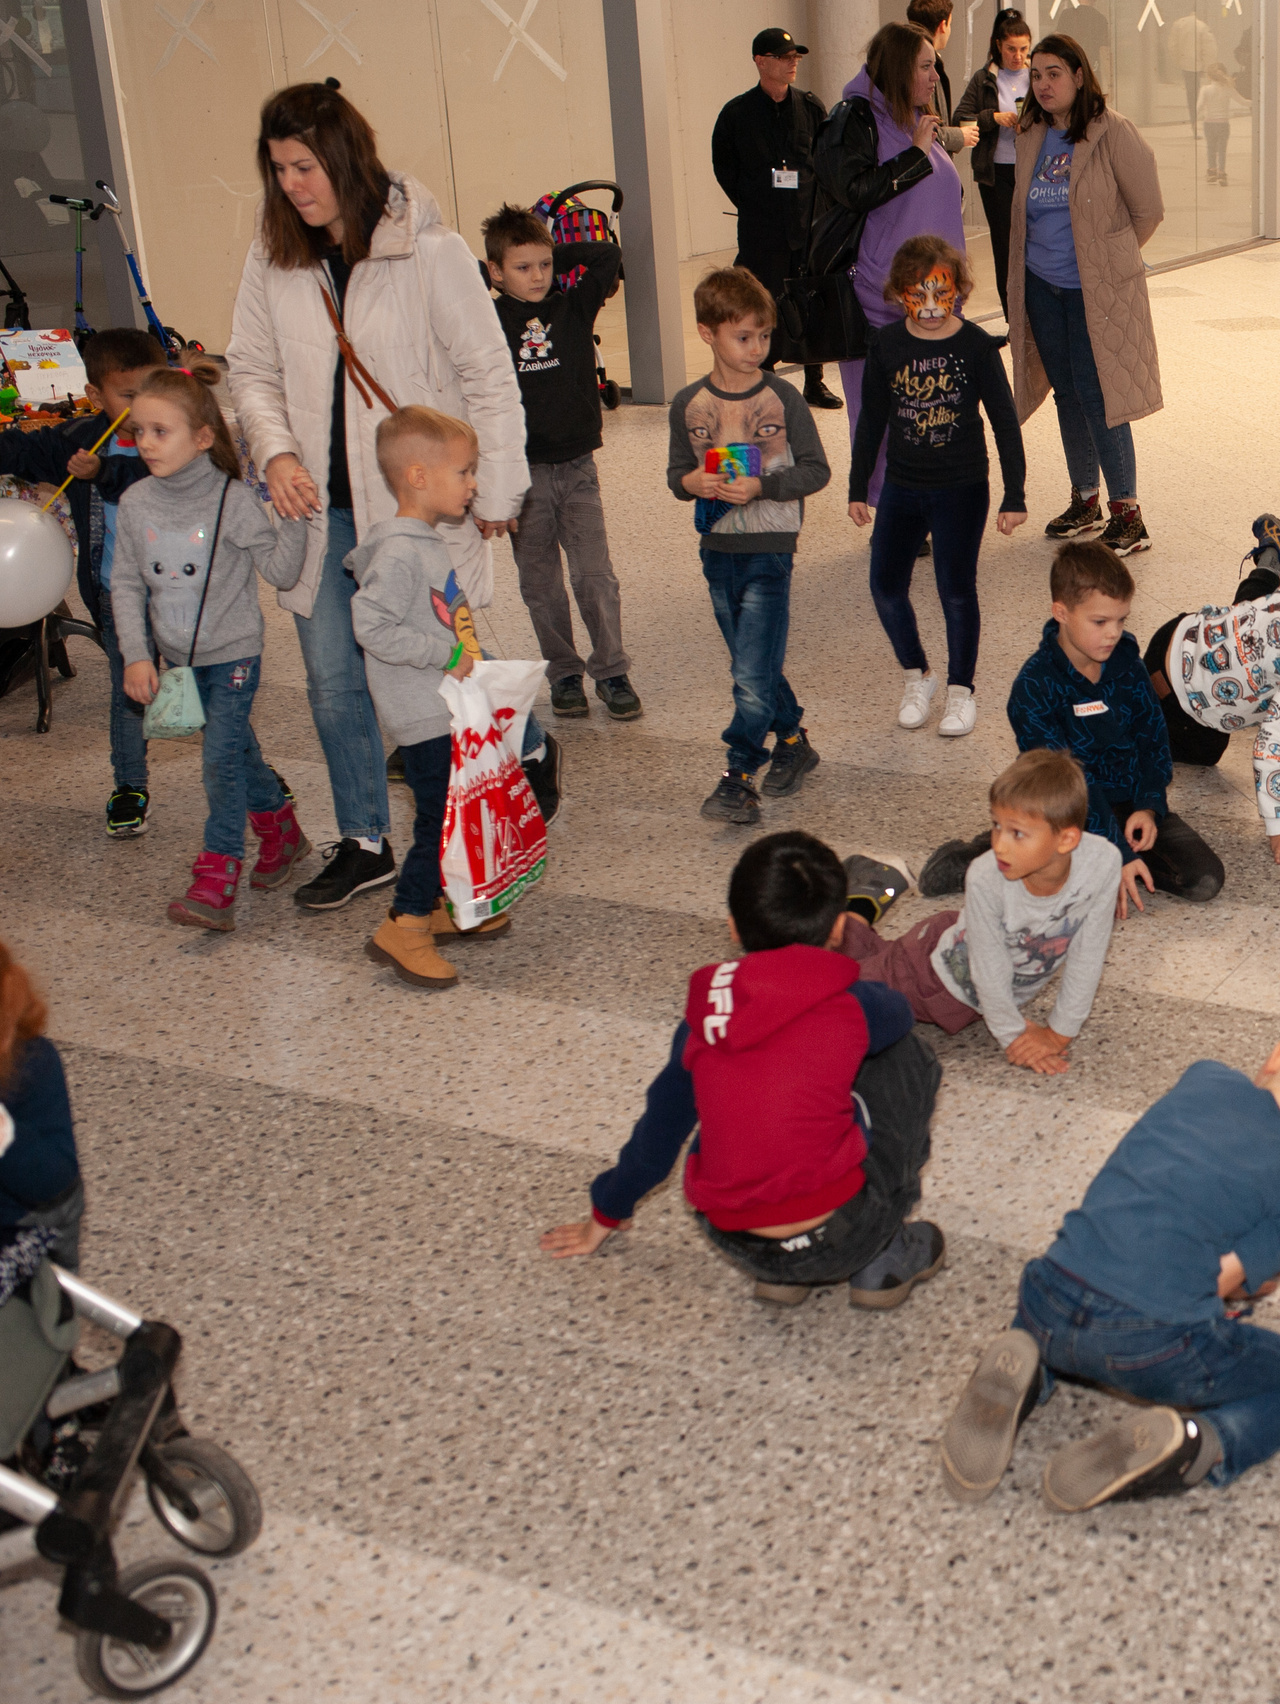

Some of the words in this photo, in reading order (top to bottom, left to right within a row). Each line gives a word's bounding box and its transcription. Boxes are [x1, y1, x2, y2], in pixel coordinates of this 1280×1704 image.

[891, 365, 954, 400] Magic
[913, 359, 917, 372] I
[919, 357, 947, 373] NEED
[702, 961, 740, 1046] UFC
